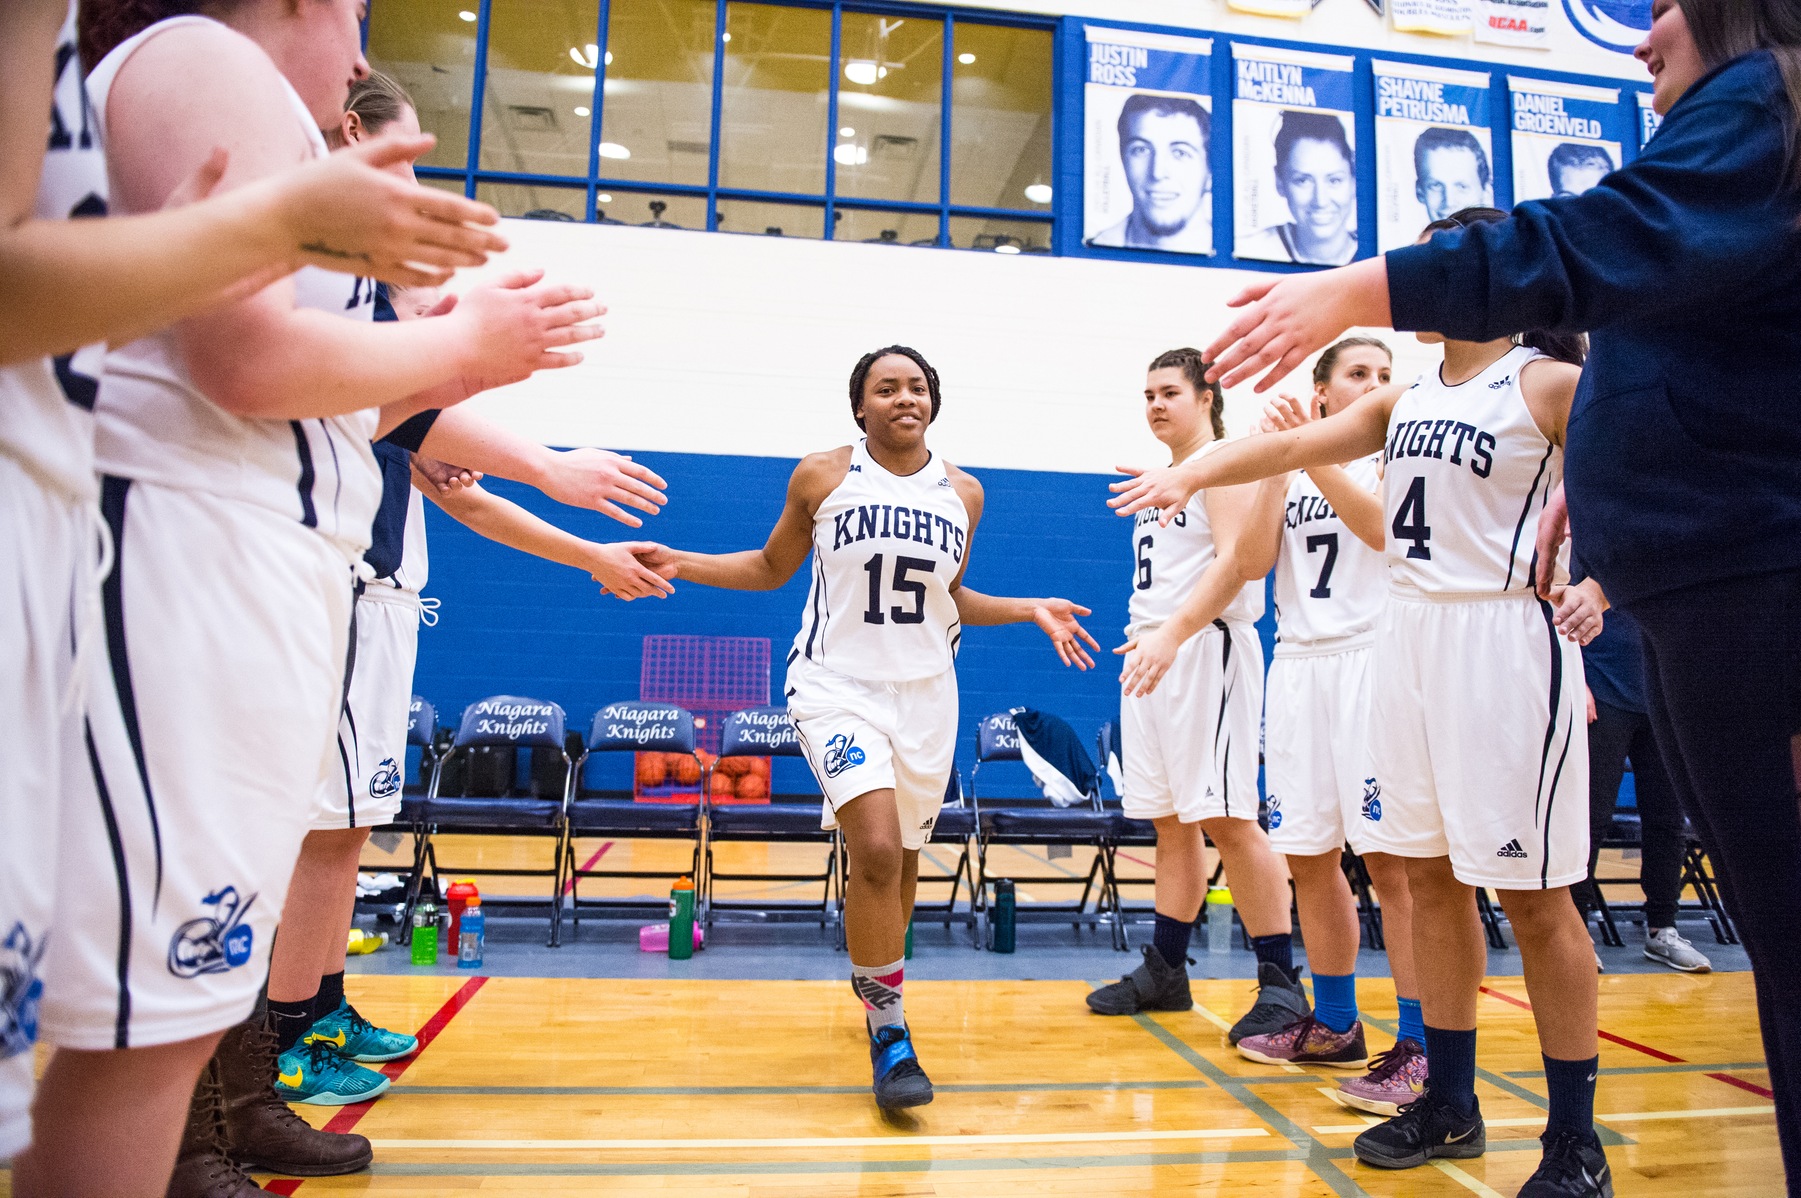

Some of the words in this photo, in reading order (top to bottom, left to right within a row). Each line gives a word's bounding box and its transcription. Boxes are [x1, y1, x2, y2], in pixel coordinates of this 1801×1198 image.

[1090, 43, 1148, 69] JUSTIN
[1091, 64, 1137, 87] ROSS
[1237, 59, 1302, 84] KAITLYN
[1237, 80, 1316, 106] McKENNA
[1379, 77, 1444, 103] SHAYNE
[1380, 97, 1470, 125] PETRUSMA
[1513, 91, 1567, 117] DANIEL
[1514, 111, 1602, 139] GROENVELD
[1384, 420, 1496, 479] NIGHTS
[1392, 476, 1431, 561] 4
[833, 504, 964, 564] KNIGHTS
[1137, 534, 1153, 590] 6
[1306, 532, 1338, 598] 7
[864, 553, 936, 624] 15
[475, 701, 553, 721] Niagara
[603, 706, 679, 726] Niagara
[735, 711, 788, 730] Niaga
[476, 718, 548, 740] Knights
[606, 723, 676, 745] Knights
[739, 727, 798, 749] Knight
[849, 750, 863, 761] nc
[1496, 850, 1528, 859] adidas
